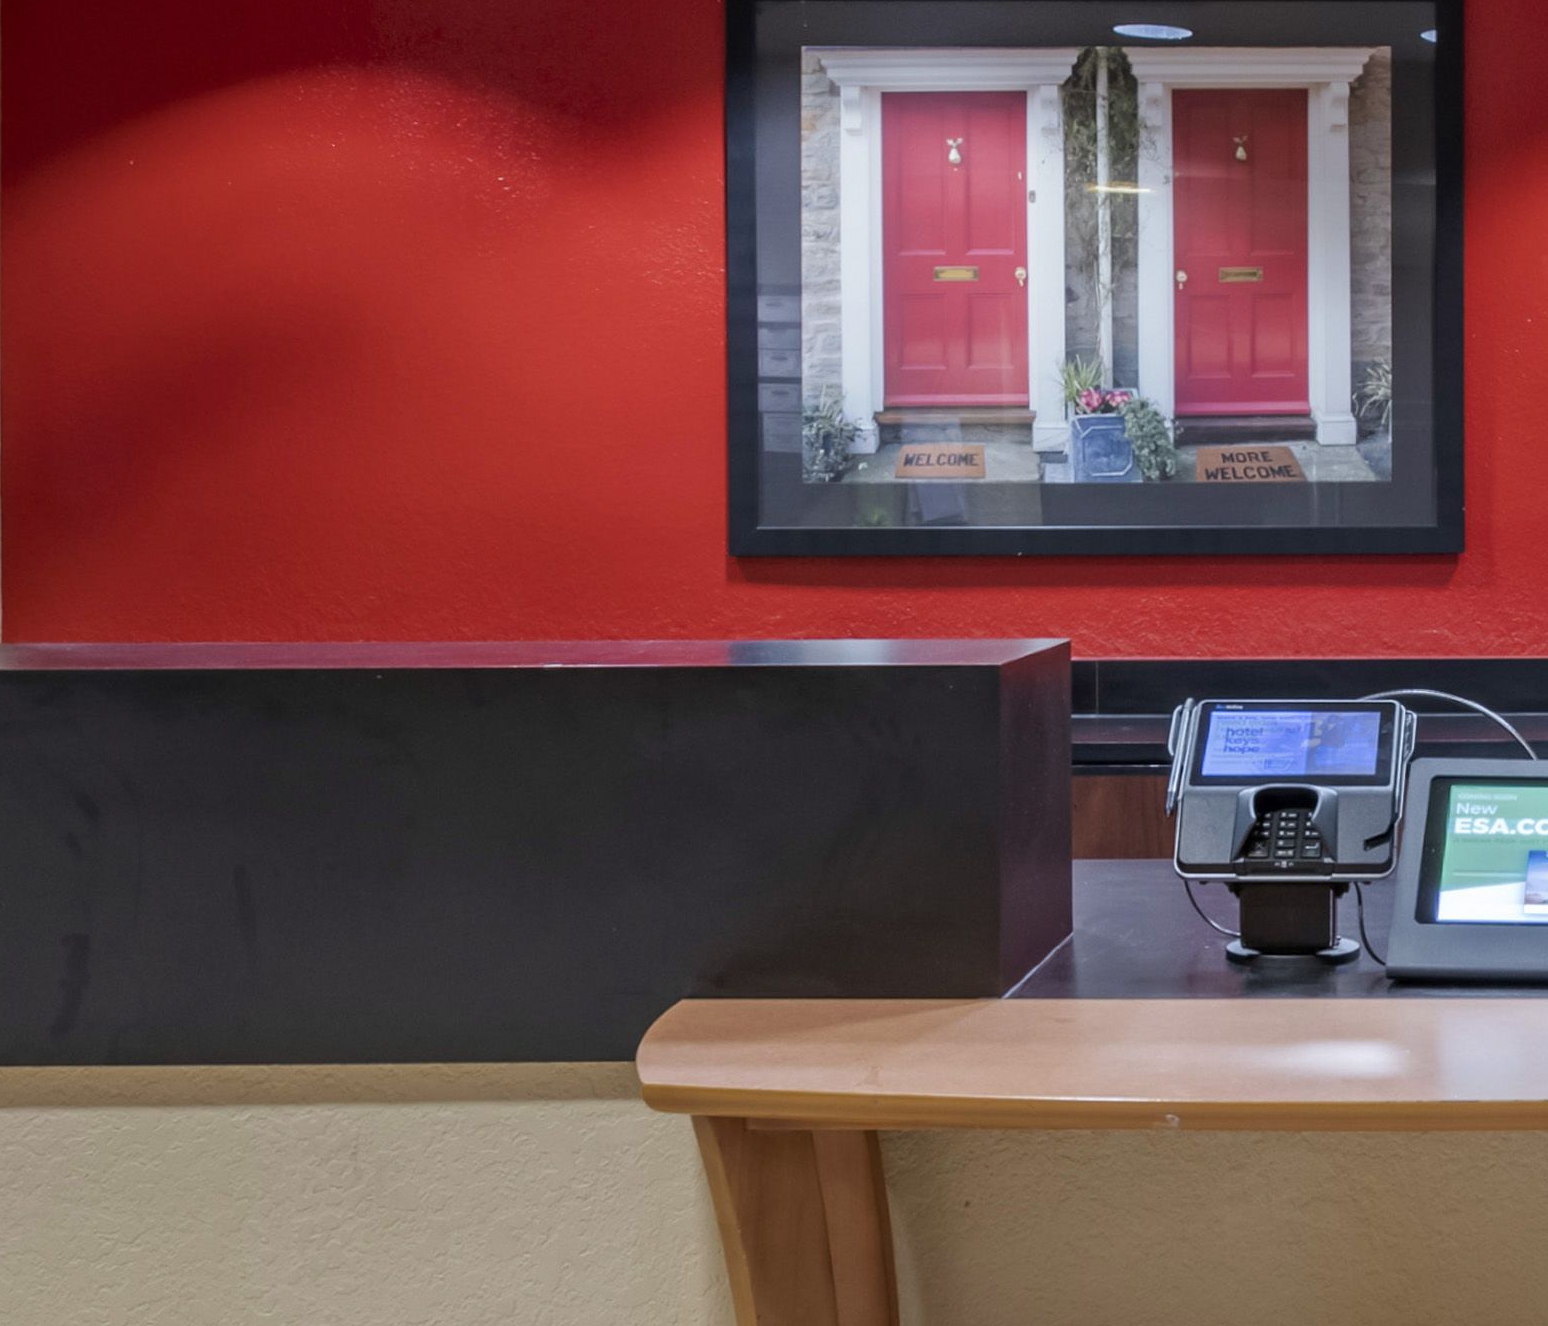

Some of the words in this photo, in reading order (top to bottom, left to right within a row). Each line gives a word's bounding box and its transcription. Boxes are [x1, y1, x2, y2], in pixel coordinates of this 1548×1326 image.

[903, 453, 979, 467] WELCOME
[1221, 451, 1274, 463] MORE
[1205, 465, 1297, 481] WELCOME
[1456, 803, 1498, 814] New
